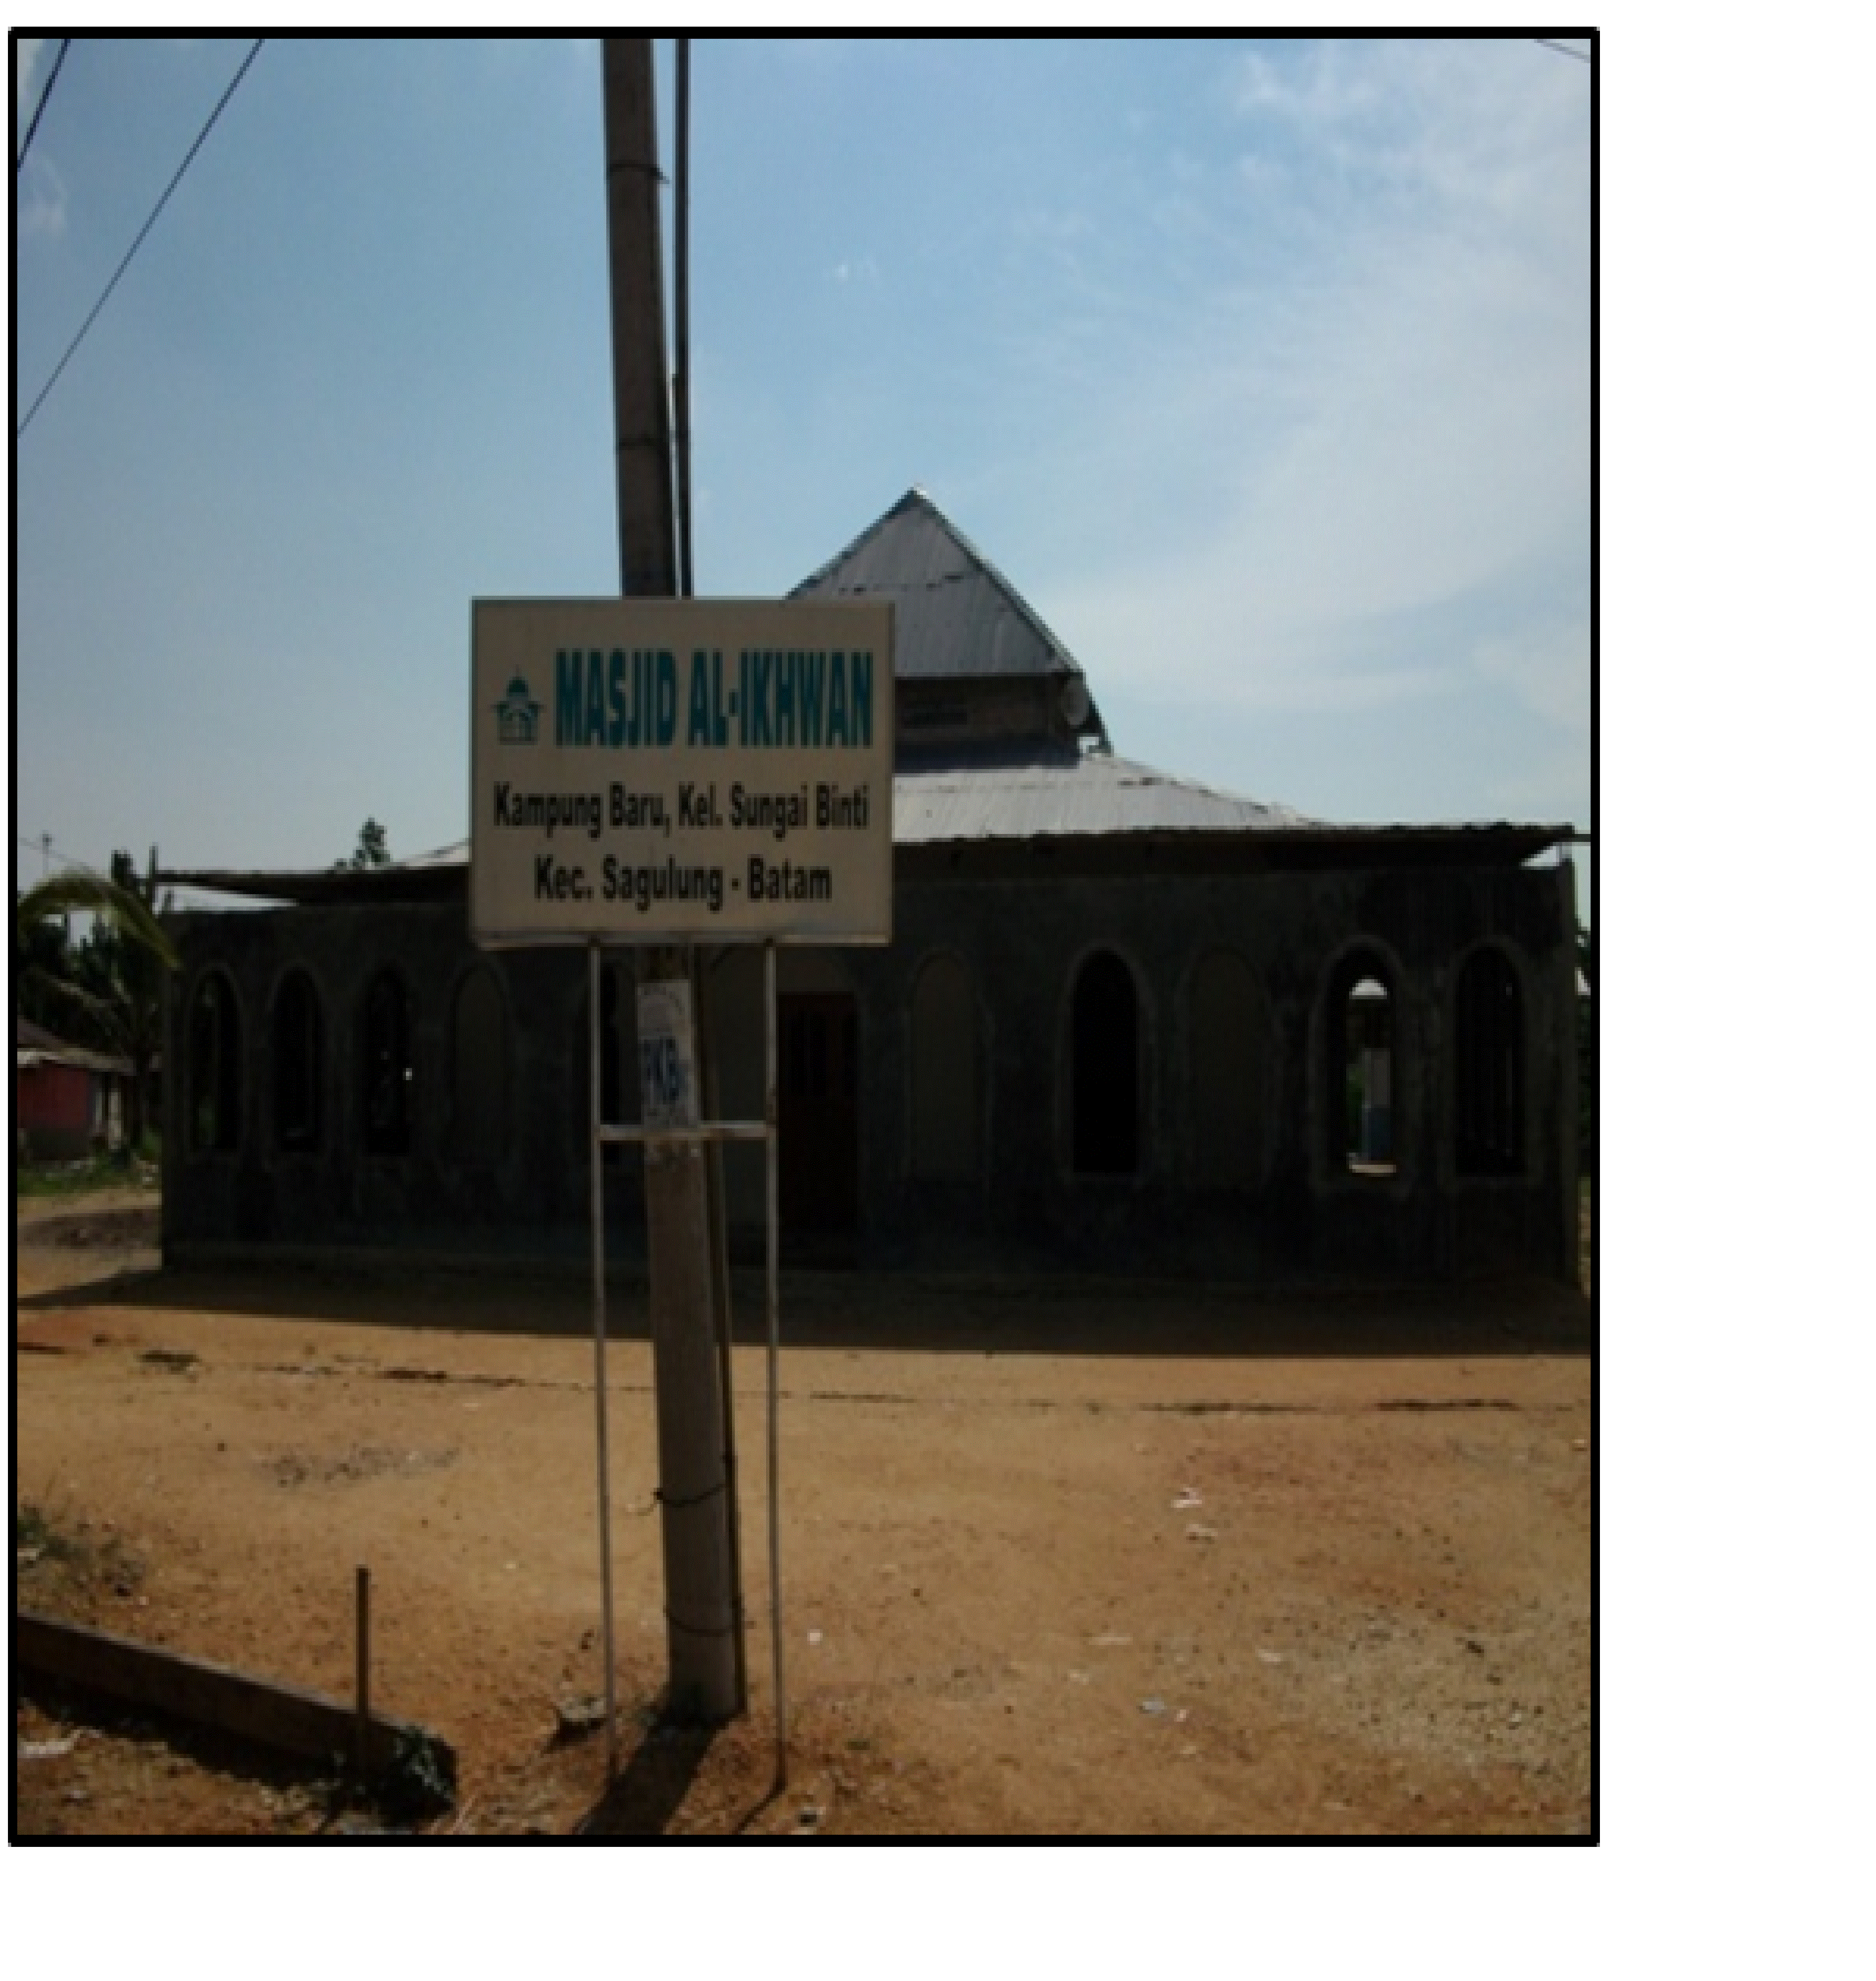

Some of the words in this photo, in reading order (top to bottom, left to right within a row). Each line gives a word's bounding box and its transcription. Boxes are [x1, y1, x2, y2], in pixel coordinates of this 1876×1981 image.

[555, 649, 676, 748] MASJID
[687, 649, 873, 748] AL-IKHWAN
[493, 782, 604, 841] Kampung
[609, 782, 670, 837] Baru,
[678, 782, 723, 828] Kel.
[730, 782, 808, 841] Sungai
[815, 782, 870, 829] Binti
[534, 855, 594, 901] Kec.
[602, 855, 723, 913] Sagulung
[748, 855, 833, 901] Batam
